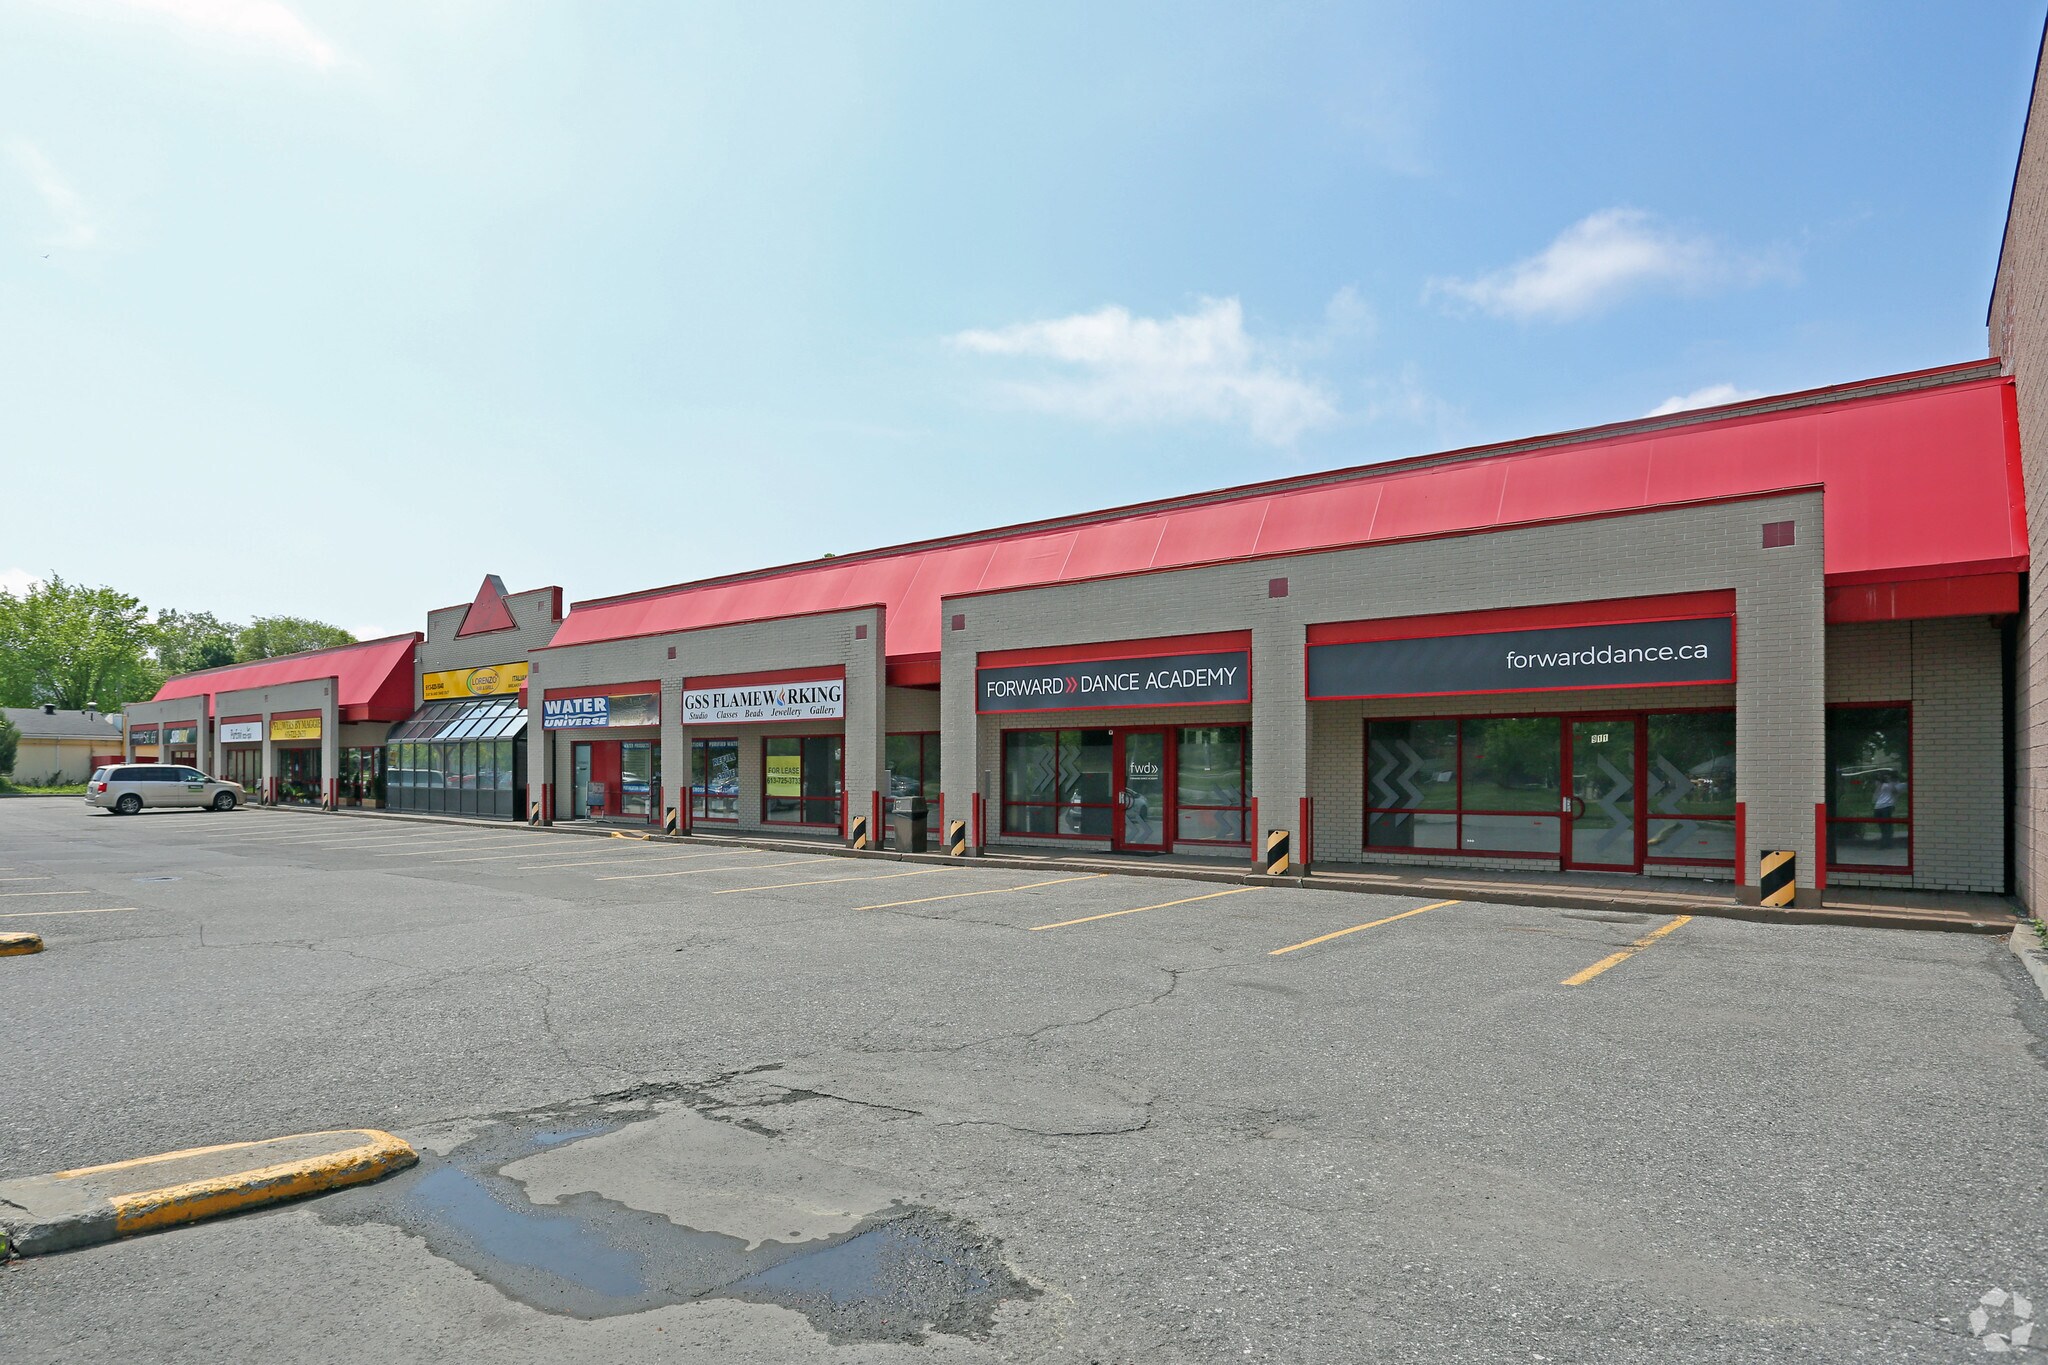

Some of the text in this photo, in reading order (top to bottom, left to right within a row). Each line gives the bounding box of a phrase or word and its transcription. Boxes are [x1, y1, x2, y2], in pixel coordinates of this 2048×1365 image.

[1506, 644, 1709, 669] forwarddance.ca
[472, 676, 498, 686] LORENZO
[987, 666, 1238, 698] FORWARD DANCE ACADEMY
[544, 697, 607, 714] WATER
[685, 694, 710, 710] GSS
[689, 705, 836, 720] Studio Classes Beads Jewellery Gallery
[712, 752, 736, 767] REFILL
[1130, 762, 1151, 774] fwd
